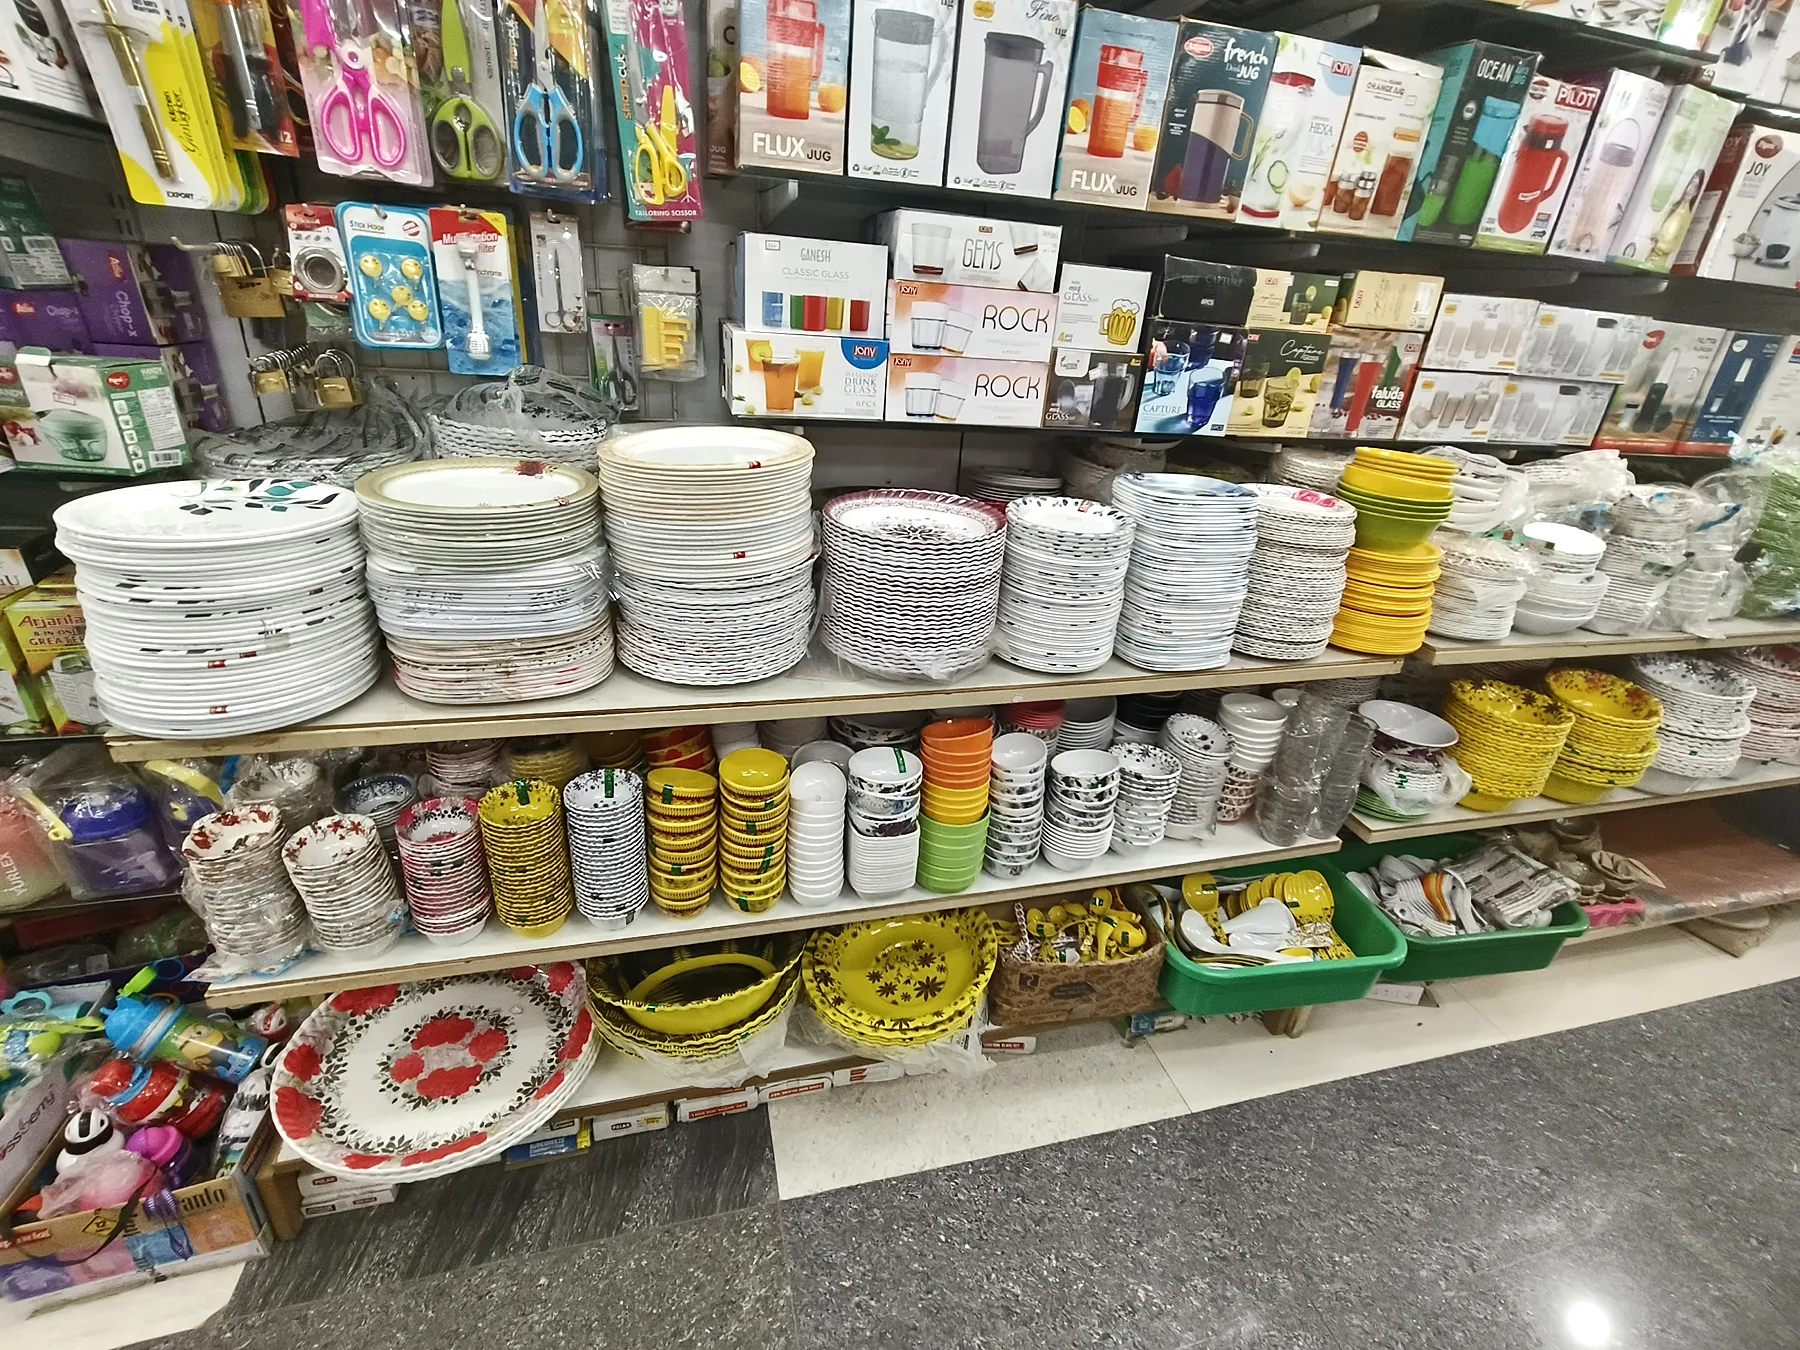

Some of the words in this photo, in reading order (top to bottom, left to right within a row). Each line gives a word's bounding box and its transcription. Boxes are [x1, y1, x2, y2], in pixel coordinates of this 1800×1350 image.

[1224, 37, 1268, 66] french
[1236, 64, 1260, 80] JUG
[1477, 58, 1516, 83] OCEAN
[1367, 82, 1392, 93] ORANGE
[1557, 87, 1596, 108] PILOT
[1309, 121, 1333, 137] HEXA
[709, 145, 727, 154] JUG
[752, 132, 805, 158] FLUX
[806, 149, 831, 162] JUG
[1746, 161, 1772, 177] JOY
[1070, 169, 1117, 194] FLUX
[1116, 185, 1137, 196] JUG
[166, 191, 194, 200] EXPORT
[634, 209, 670, 217] TAILORING
[671, 209, 697, 217] SCISSOR
[800, 247, 831, 263] GANESH
[962, 238, 1004, 270] GEMS
[781, 266, 819, 278] CLASSIC
[821, 269, 850, 280] GLASS
[900, 285, 917, 295] Jony
[1063, 292, 1092, 303] GLASS
[982, 304, 1050, 333] ROCK
[854, 345, 877, 358] Jony
[893, 358, 911, 368] Jony
[844, 384, 877, 395] GLASS
[845, 378, 876, 388] DRINK
[974, 373, 1041, 400] ROCK
[0, 387, 24, 398] ANDY
[1143, 404, 1181, 414] CAPTURE
[1376, 400, 1402, 410] GLASS
